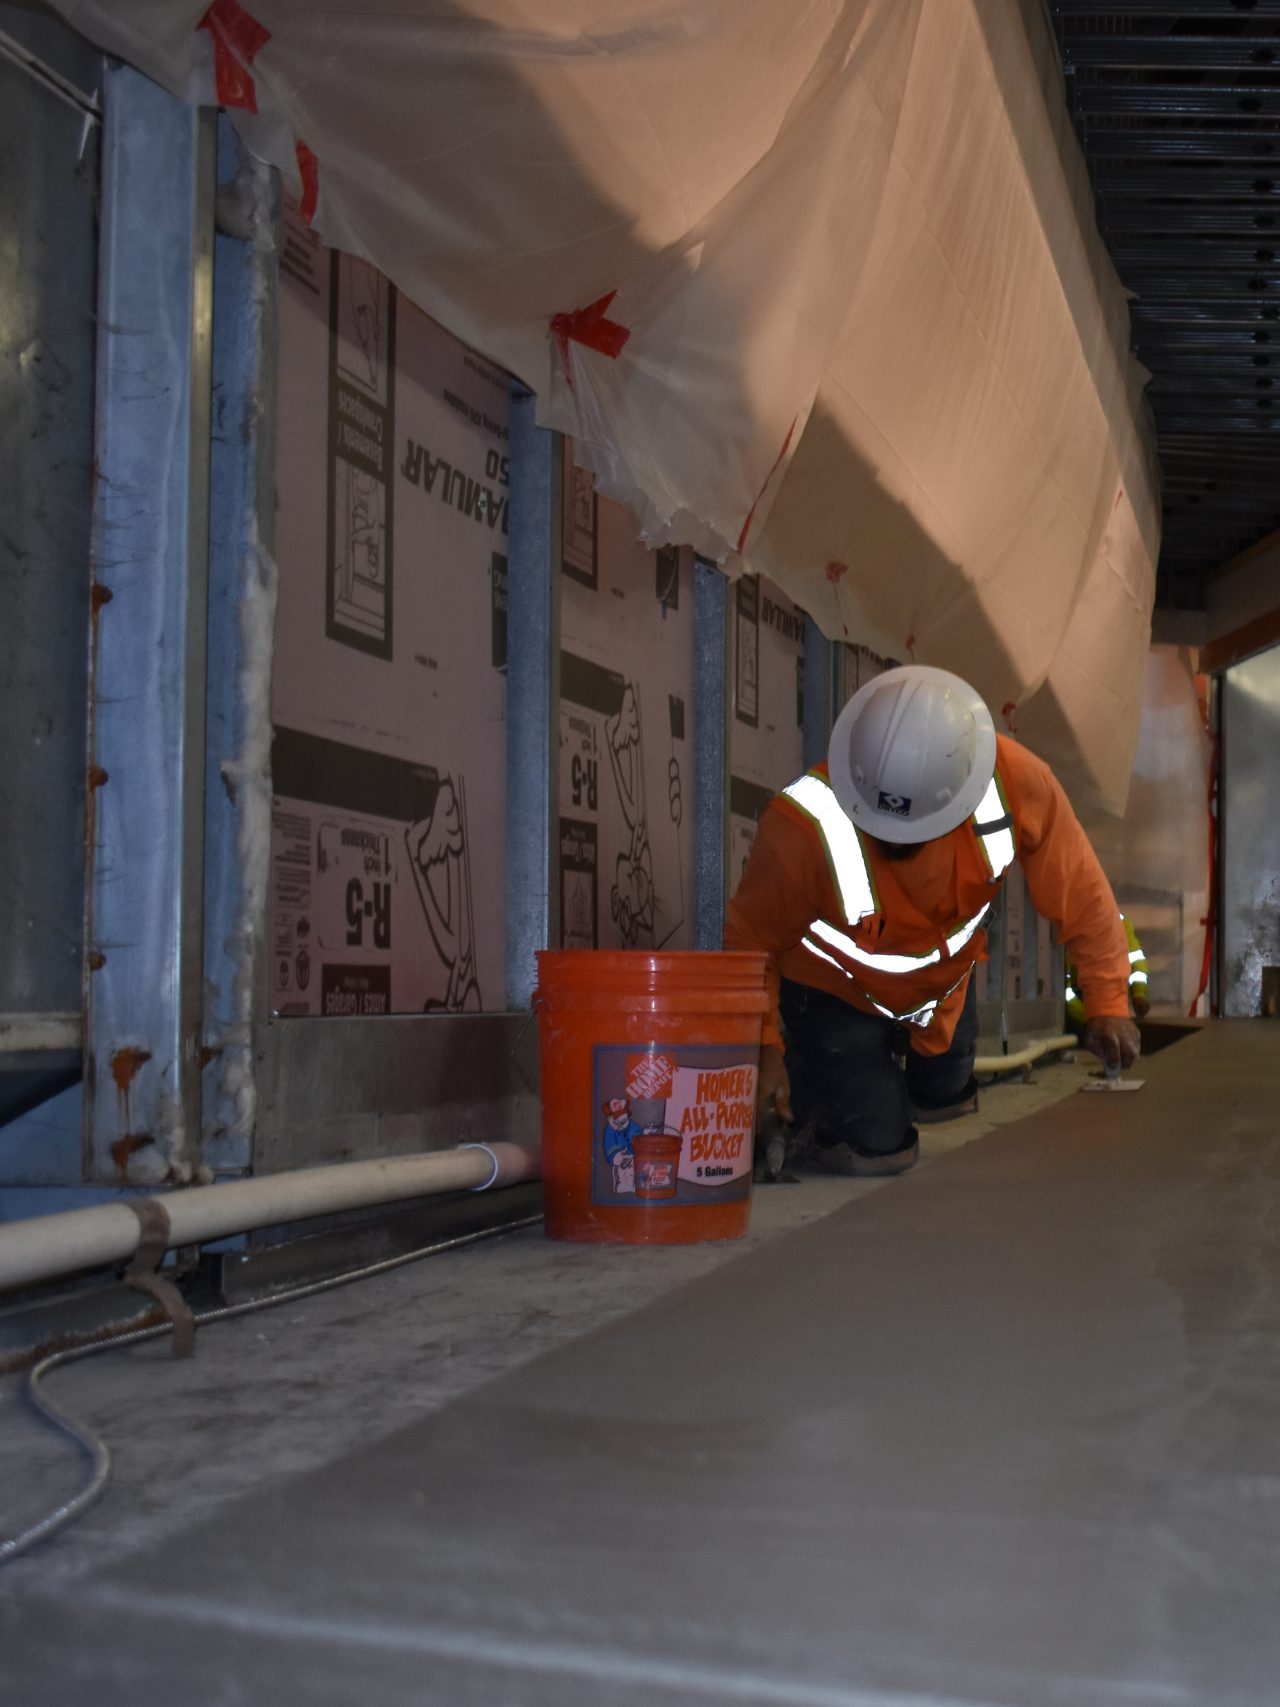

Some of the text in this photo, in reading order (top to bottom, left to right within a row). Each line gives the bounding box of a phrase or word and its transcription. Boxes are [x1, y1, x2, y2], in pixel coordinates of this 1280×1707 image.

[572, 753, 598, 811] R-5
[341, 828, 381, 856] Thickness
[364, 855, 381, 878] inch
[346, 877, 391, 949] R-5
[625, 1056, 670, 1098] HOME
[631, 1057, 651, 1077] THE
[642, 1071, 672, 1098] DEPOT
[690, 1132, 745, 1162] BUCKET
[696, 1165, 733, 1177] 5 Gallons
